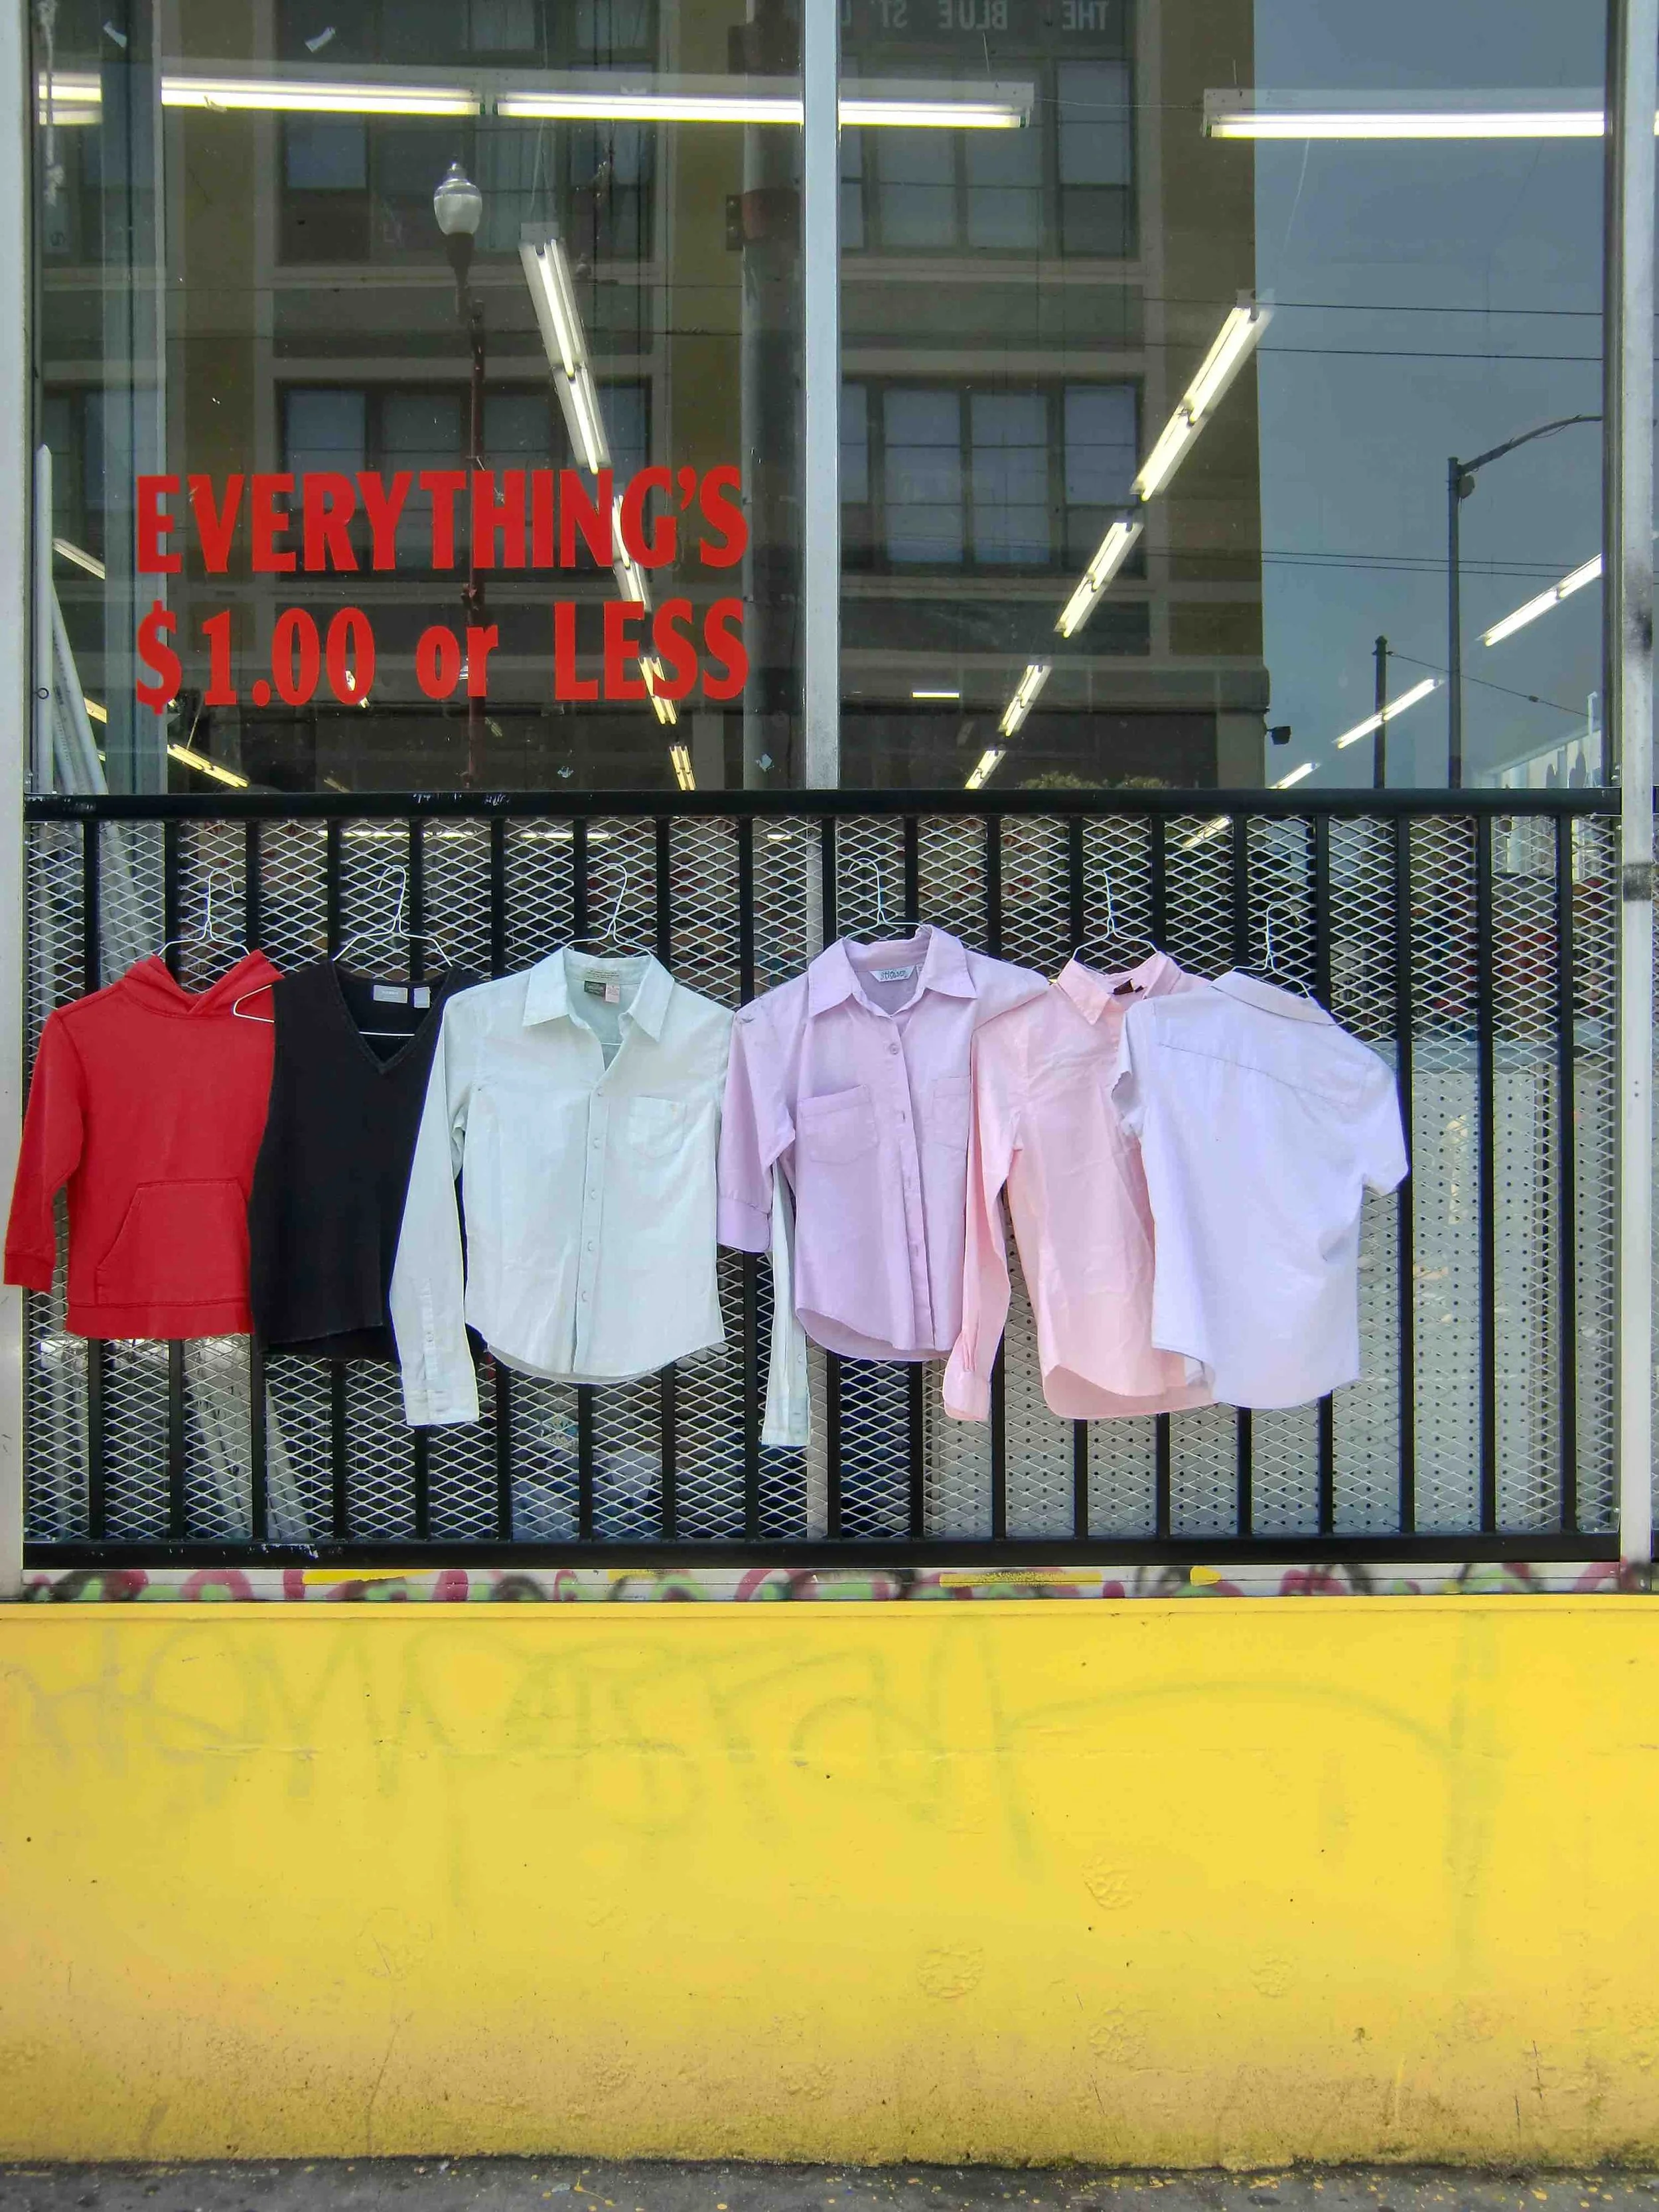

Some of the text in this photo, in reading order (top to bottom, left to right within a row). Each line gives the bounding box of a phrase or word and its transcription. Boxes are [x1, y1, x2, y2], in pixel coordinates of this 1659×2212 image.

[137, 465, 749, 573] EVERYTHING'S
[137, 597, 749, 715] $1.00 or LESS
